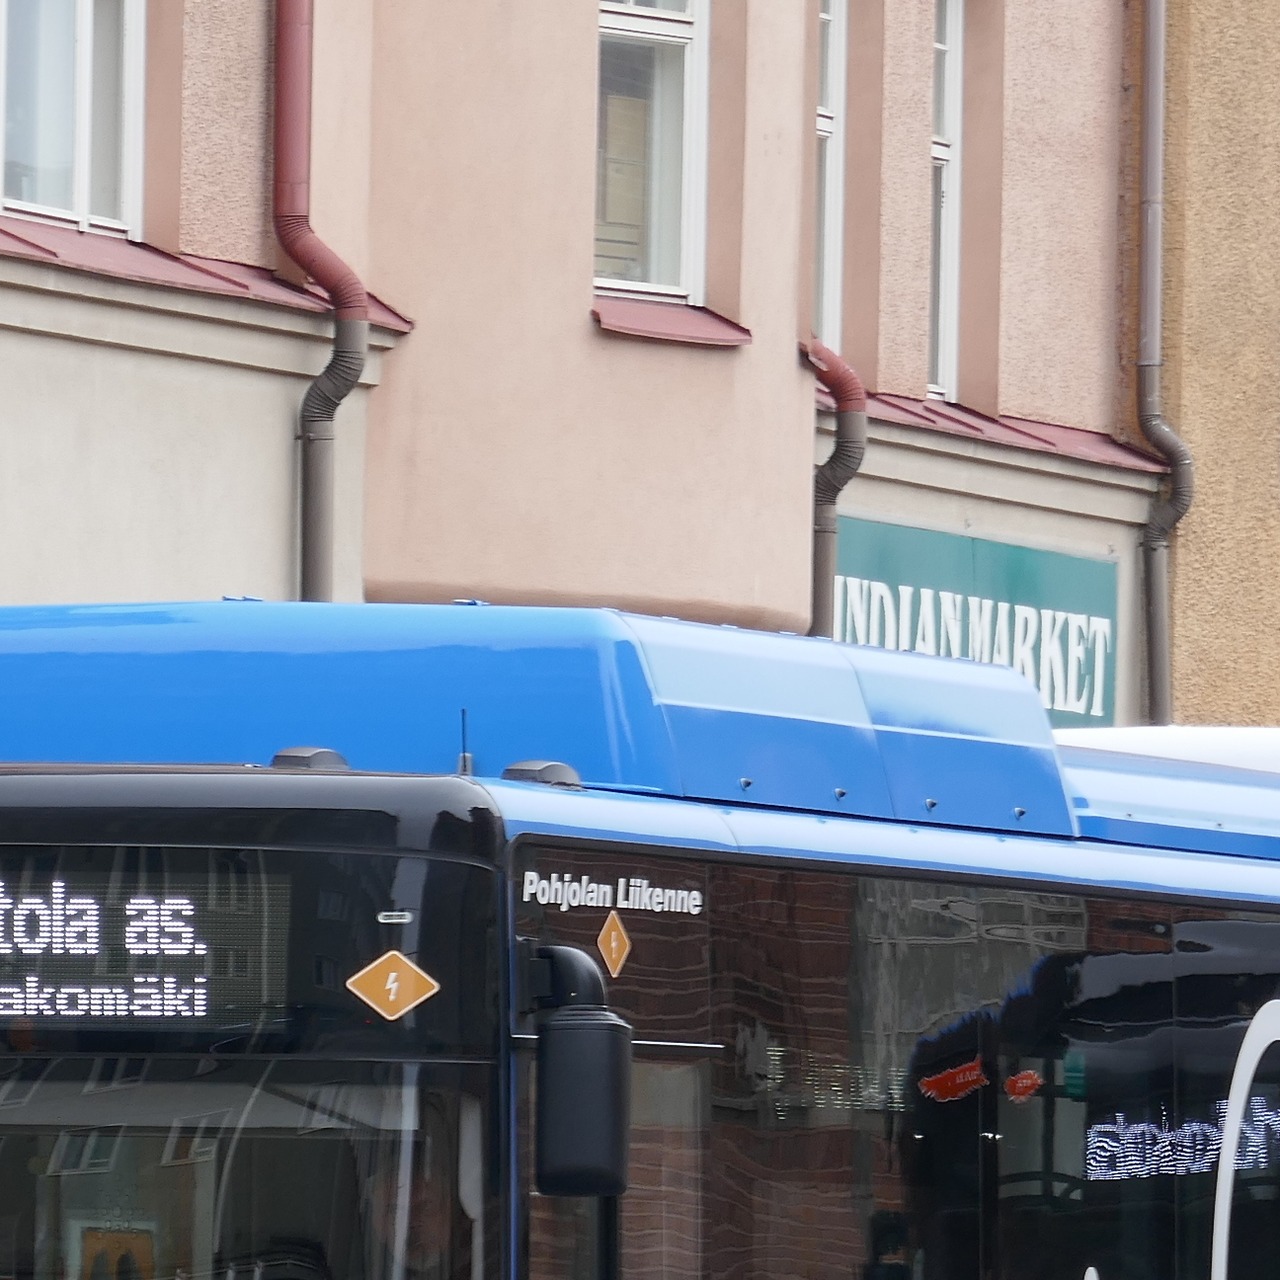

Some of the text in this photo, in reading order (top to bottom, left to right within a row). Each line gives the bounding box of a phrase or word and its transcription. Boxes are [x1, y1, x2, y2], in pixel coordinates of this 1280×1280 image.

[833, 575, 1111, 716] INDIAN MARKET
[523, 871, 703, 915] Pohjolan Liikenne
[125, 899, 208, 955] as.
